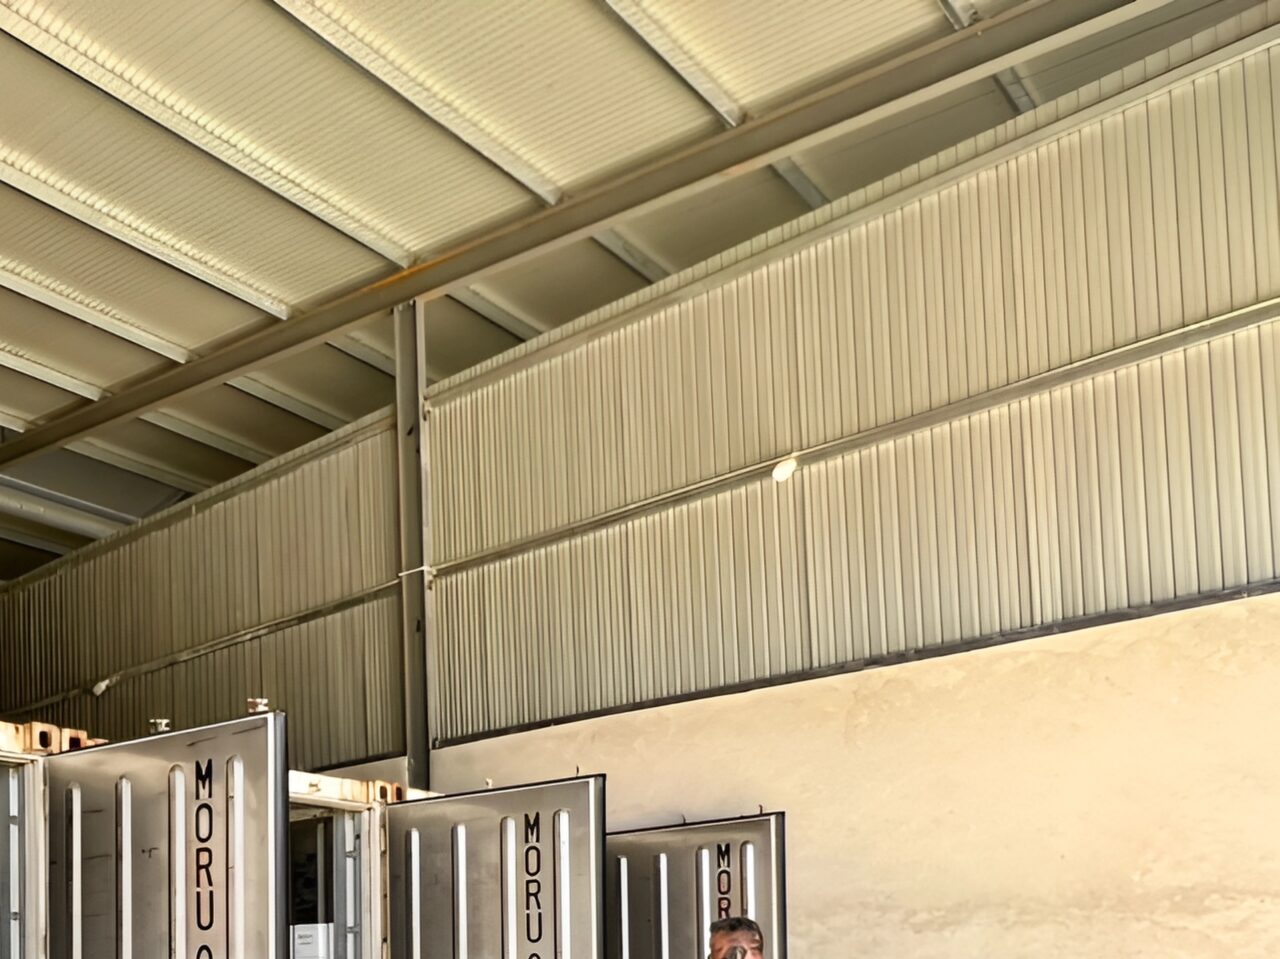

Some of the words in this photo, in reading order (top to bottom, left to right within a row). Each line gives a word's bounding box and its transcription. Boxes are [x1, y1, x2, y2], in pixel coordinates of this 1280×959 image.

[195, 759, 214, 931] MORU
[524, 812, 543, 943] MORU
[717, 843, 731, 919] MOR
